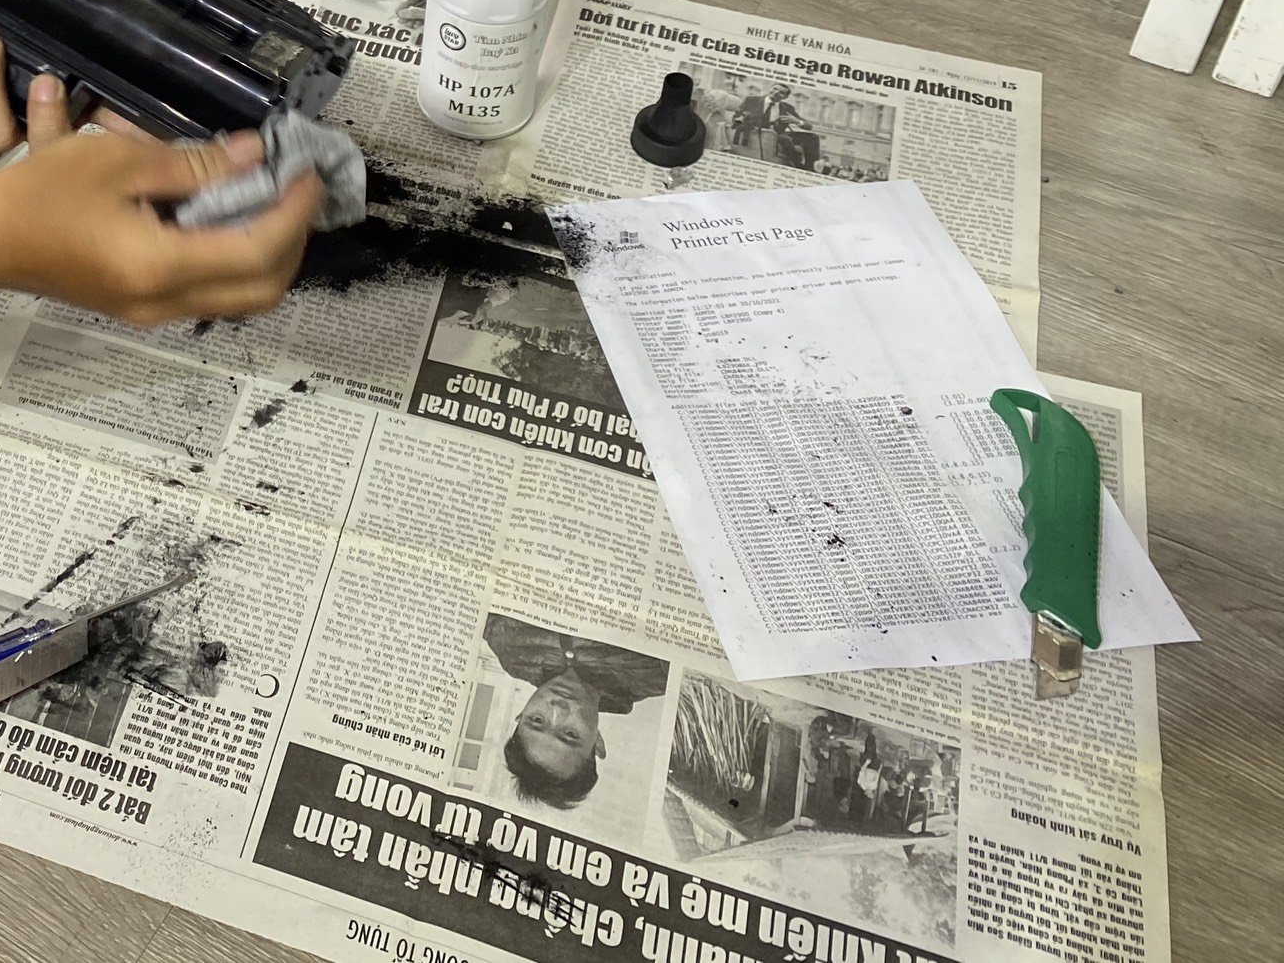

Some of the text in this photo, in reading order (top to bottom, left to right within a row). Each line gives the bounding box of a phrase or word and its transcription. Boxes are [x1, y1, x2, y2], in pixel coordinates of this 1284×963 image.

[364, 20, 412, 43] xác
[746, 26, 781, 42] NHIỆT
[658, 24, 700, 48] biết
[702, 36, 742, 56] của
[744, 43, 791, 67] siêu
[837, 62, 911, 92] Rowan
[914, 79, 1013, 112] Atkinson
[438, 73, 515, 98] HP 107A
[448, 99, 501, 118] M135
[662, 215, 744, 233] Windows
[670, 227, 815, 251] Printer Test Page
[445, 373, 503, 405] Thọ?
[505, 386, 551, 420] Phú
[417, 392, 461, 423] trai
[461, 402, 507, 432] con
[570, 405, 604, 432] bố
[509, 416, 575, 454] khiến
[577, 434, 624, 464] cơn
[8, 723, 36, 750] đồ
[331, 713, 364, 732] chứng
[365, 724, 391, 740] nhân
[33, 732, 79, 765] cầm
[392, 733, 412, 747] của
[3, 752, 64, 793] tượng
[76, 751, 128, 788] tiệm
[125, 764, 157, 794] tại
[63, 775, 100, 807] đối
[98, 787, 115, 812] 2
[334, 762, 434, 830] vong
[114, 792, 152, 825] Bắt
[292, 804, 373, 865] tâm
[486, 812, 538, 862] vợ
[1049, 820, 1076, 837] kinh
[1100, 834, 1124, 852] truy
[545, 835, 613, 888] em
[1126, 840, 1143, 857] Vụ
[377, 830, 484, 898] nhẫn
[620, 859, 671, 910] và
[681, 877, 750, 937] mẹ
[346, 918, 391, 955] TỤNG
